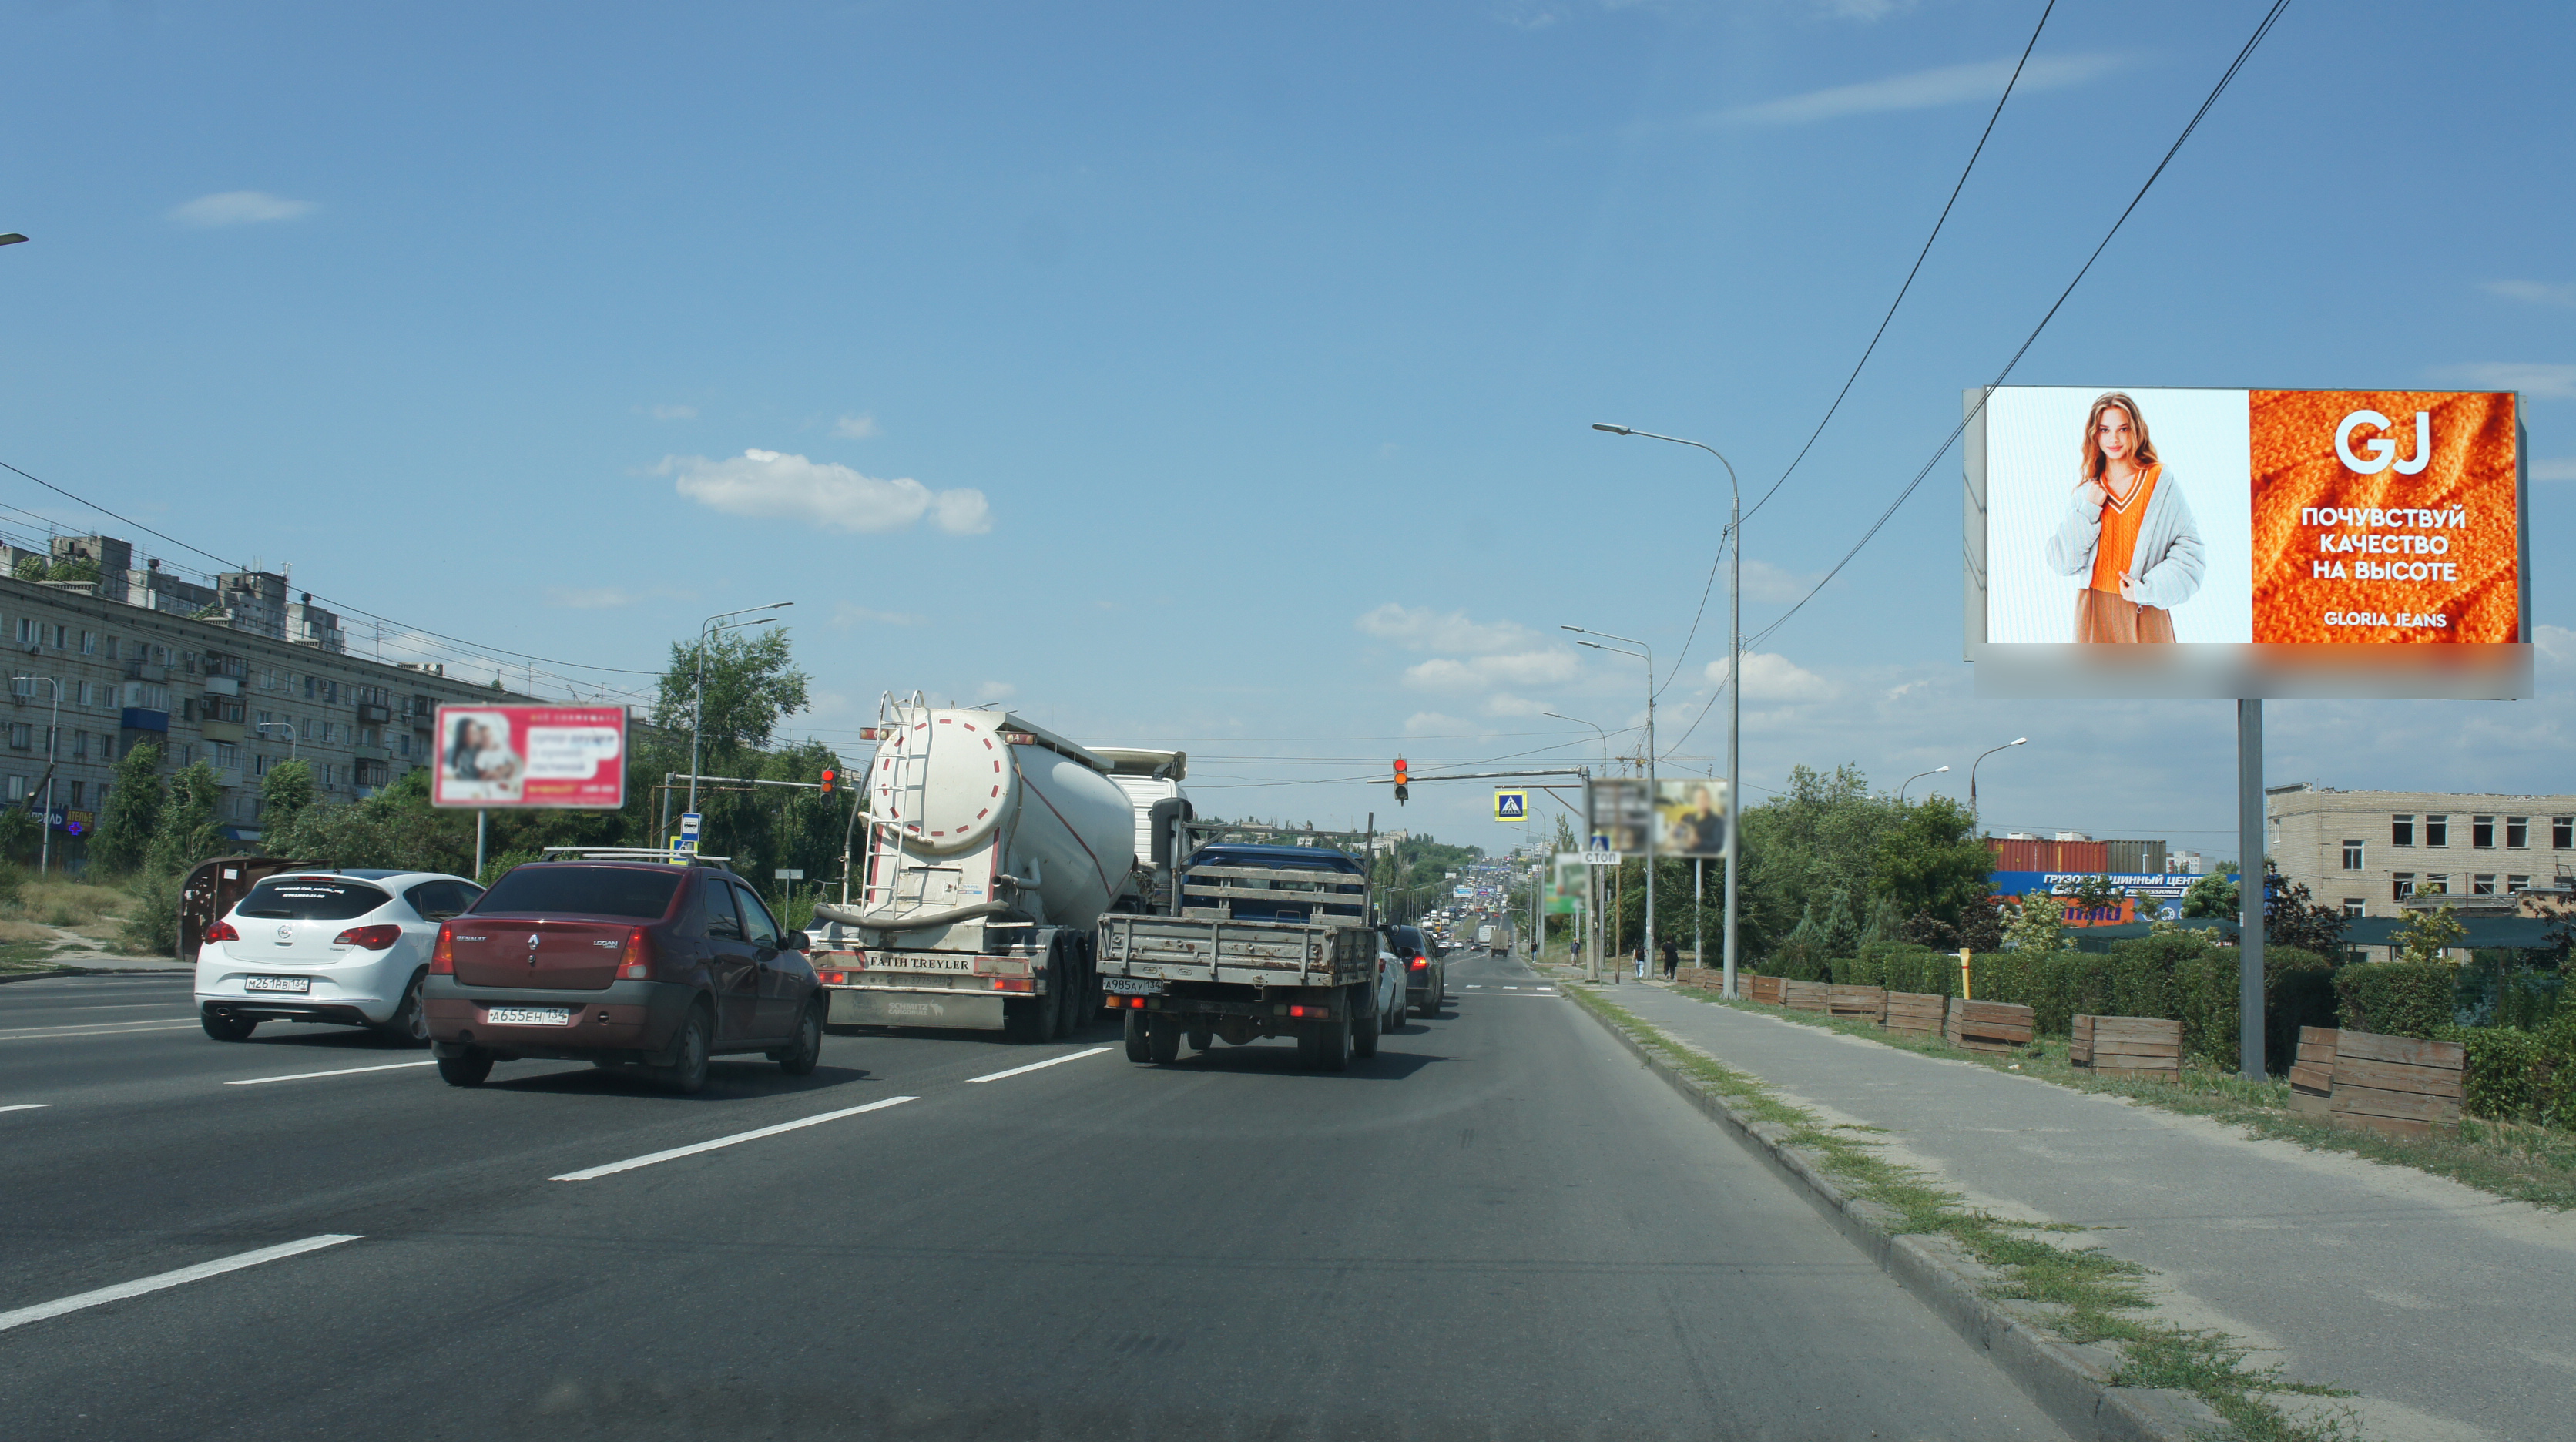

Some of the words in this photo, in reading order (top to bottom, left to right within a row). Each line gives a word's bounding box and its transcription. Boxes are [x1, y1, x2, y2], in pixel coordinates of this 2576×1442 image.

[2335, 409, 2430, 475] GJ
[2302, 504, 2466, 528] ПОЧУВСТВУЙ
[2320, 534, 2449, 555] КАЧЕСТВО
[2313, 560, 2347, 579] НА
[2355, 561, 2457, 582] ВЫСОТЕ
[2324, 611, 2390, 626] GLORIA
[2394, 612, 2447, 628] JEANS
[67, 810, 93, 823] АТЕЛЬЕ
[1585, 853, 1616, 863] СТОП
[2109, 874, 2164, 885] ШИННЫЙ
[870, 957, 907, 967] FATIH
[911, 957, 968, 970] TREYLER
[1145, 981, 1162, 989] 134
[492, 1008, 542, 1022] А655ЕН
[546, 1009, 566, 1019] 134
